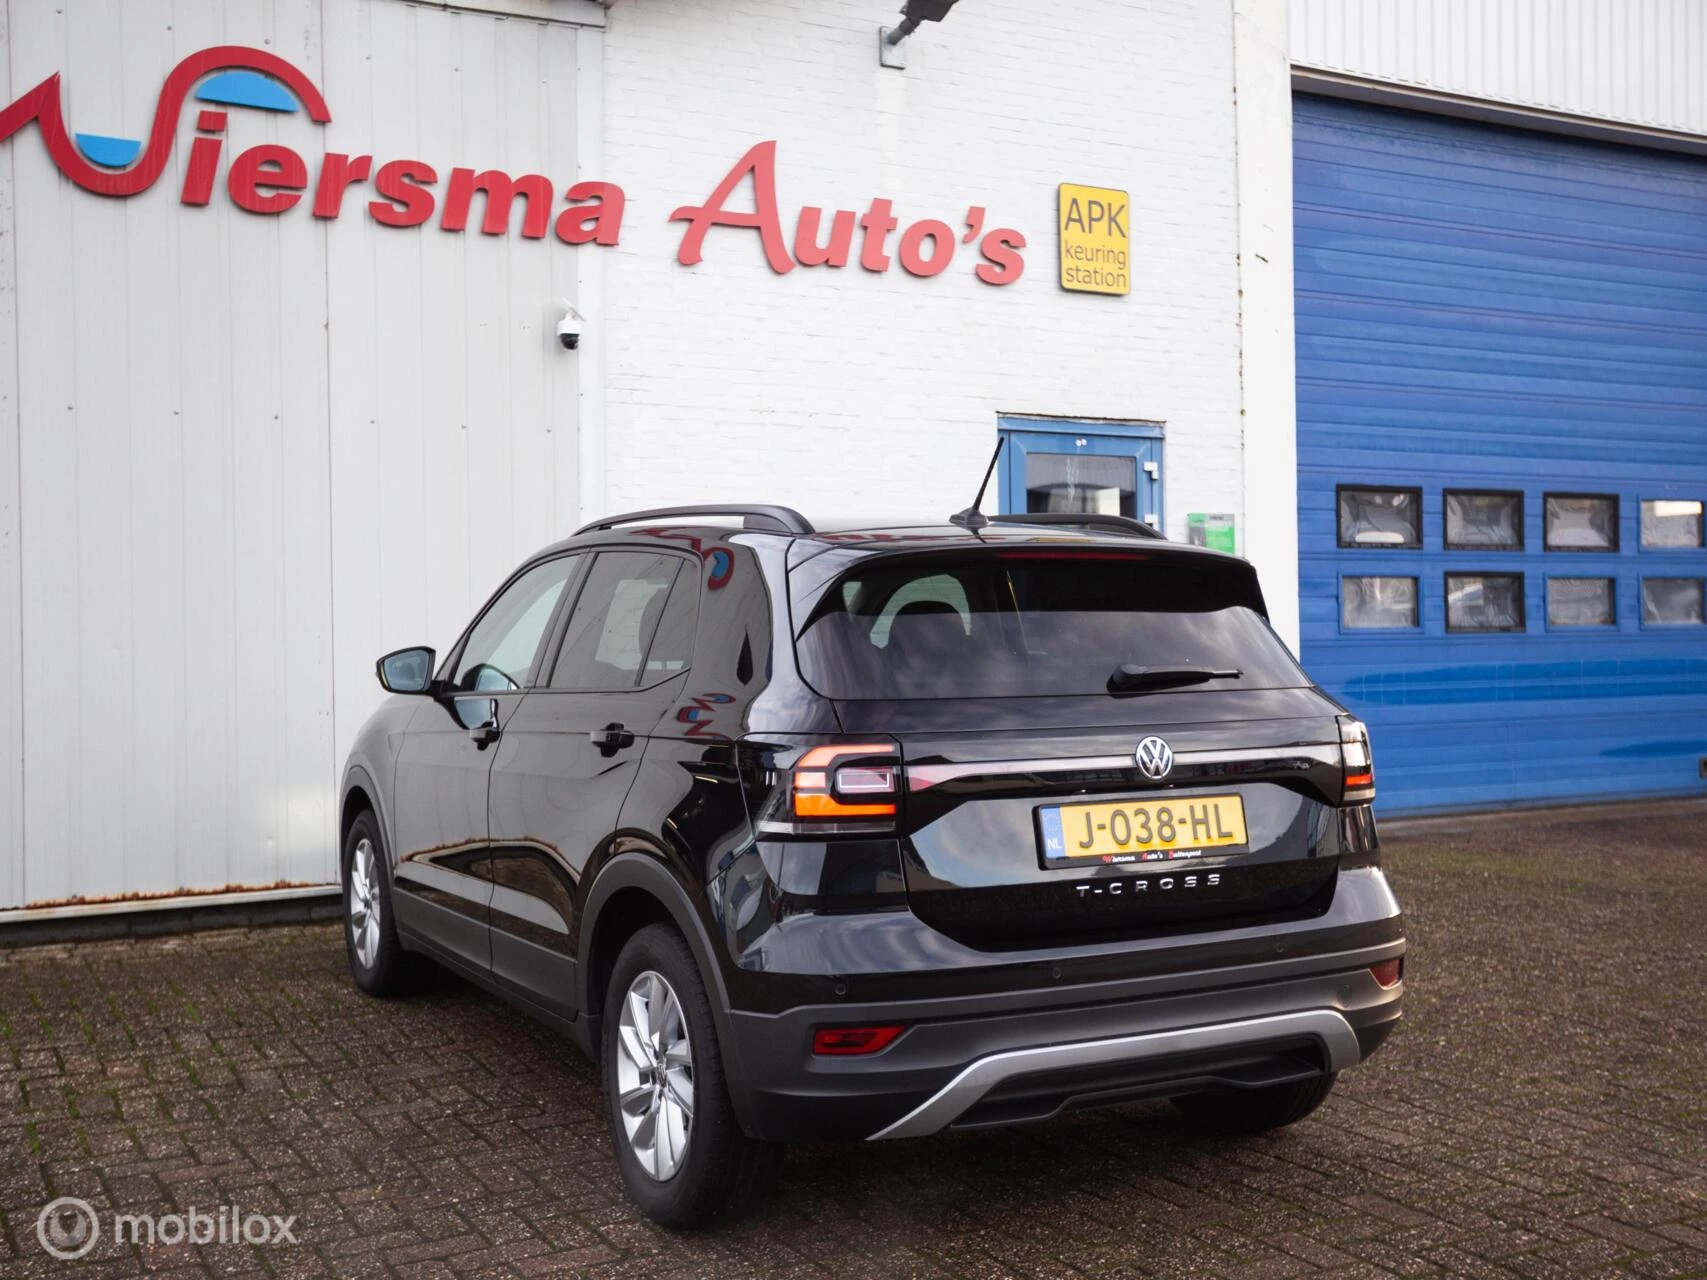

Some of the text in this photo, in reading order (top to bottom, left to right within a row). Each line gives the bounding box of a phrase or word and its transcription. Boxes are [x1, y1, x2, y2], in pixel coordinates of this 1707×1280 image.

[668, 140, 1026, 285] Auto's
[1064, 197, 1127, 238] APK
[1064, 239, 1127, 270] keuring
[1065, 265, 1127, 288] station
[1079, 804, 1233, 849] J-038-HL
[1047, 838, 1062, 850] NL
[1076, 873, 1221, 897] T-CROSS
